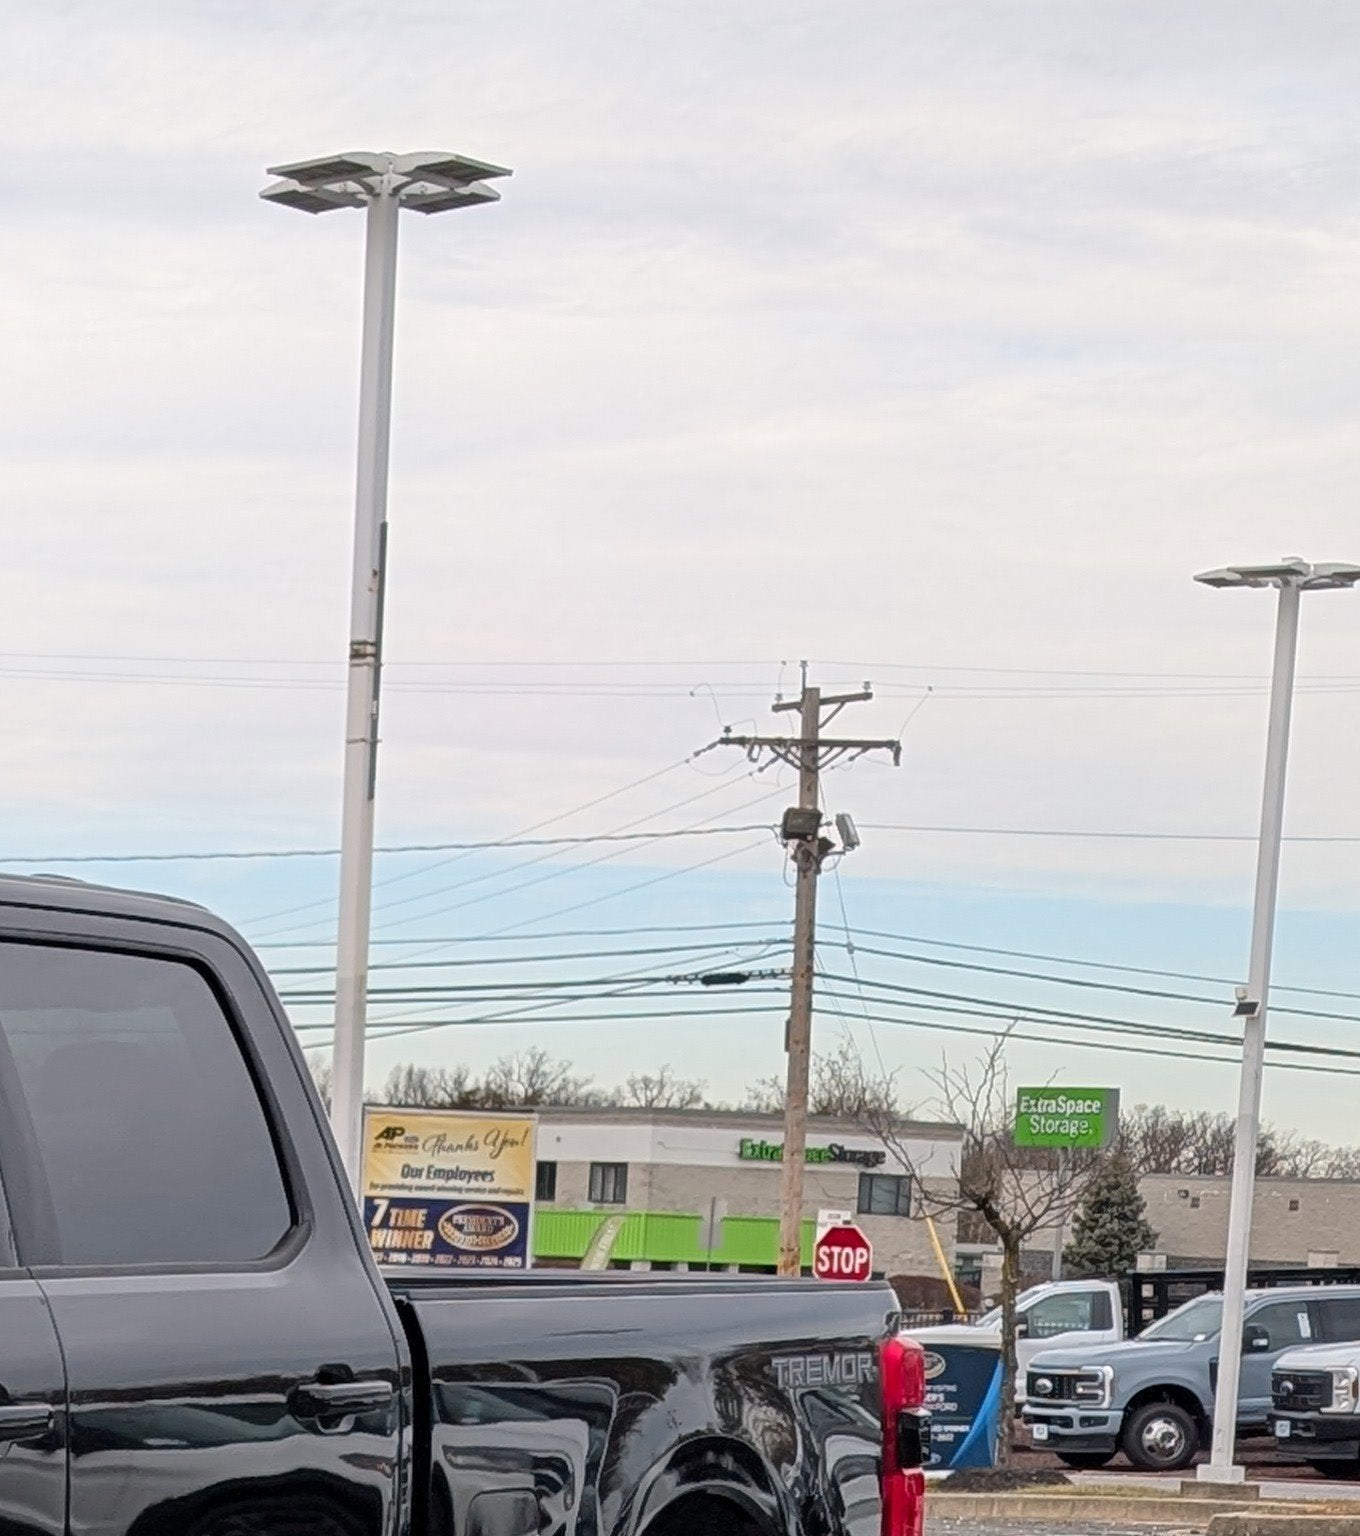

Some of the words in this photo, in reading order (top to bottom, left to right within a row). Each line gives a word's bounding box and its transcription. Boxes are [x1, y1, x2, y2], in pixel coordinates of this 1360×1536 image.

[1020, 1096, 1102, 1117] ExtraSpace
[401, 1163, 423, 1179] Our
[426, 1164, 495, 1183] Employees
[371, 1199, 390, 1227] 7
[389, 1208, 428, 1228] TIME
[371, 1229, 434, 1250] WINNER
[817, 1245, 868, 1274] STOP
[771, 1352, 874, 1387] TREMOR
